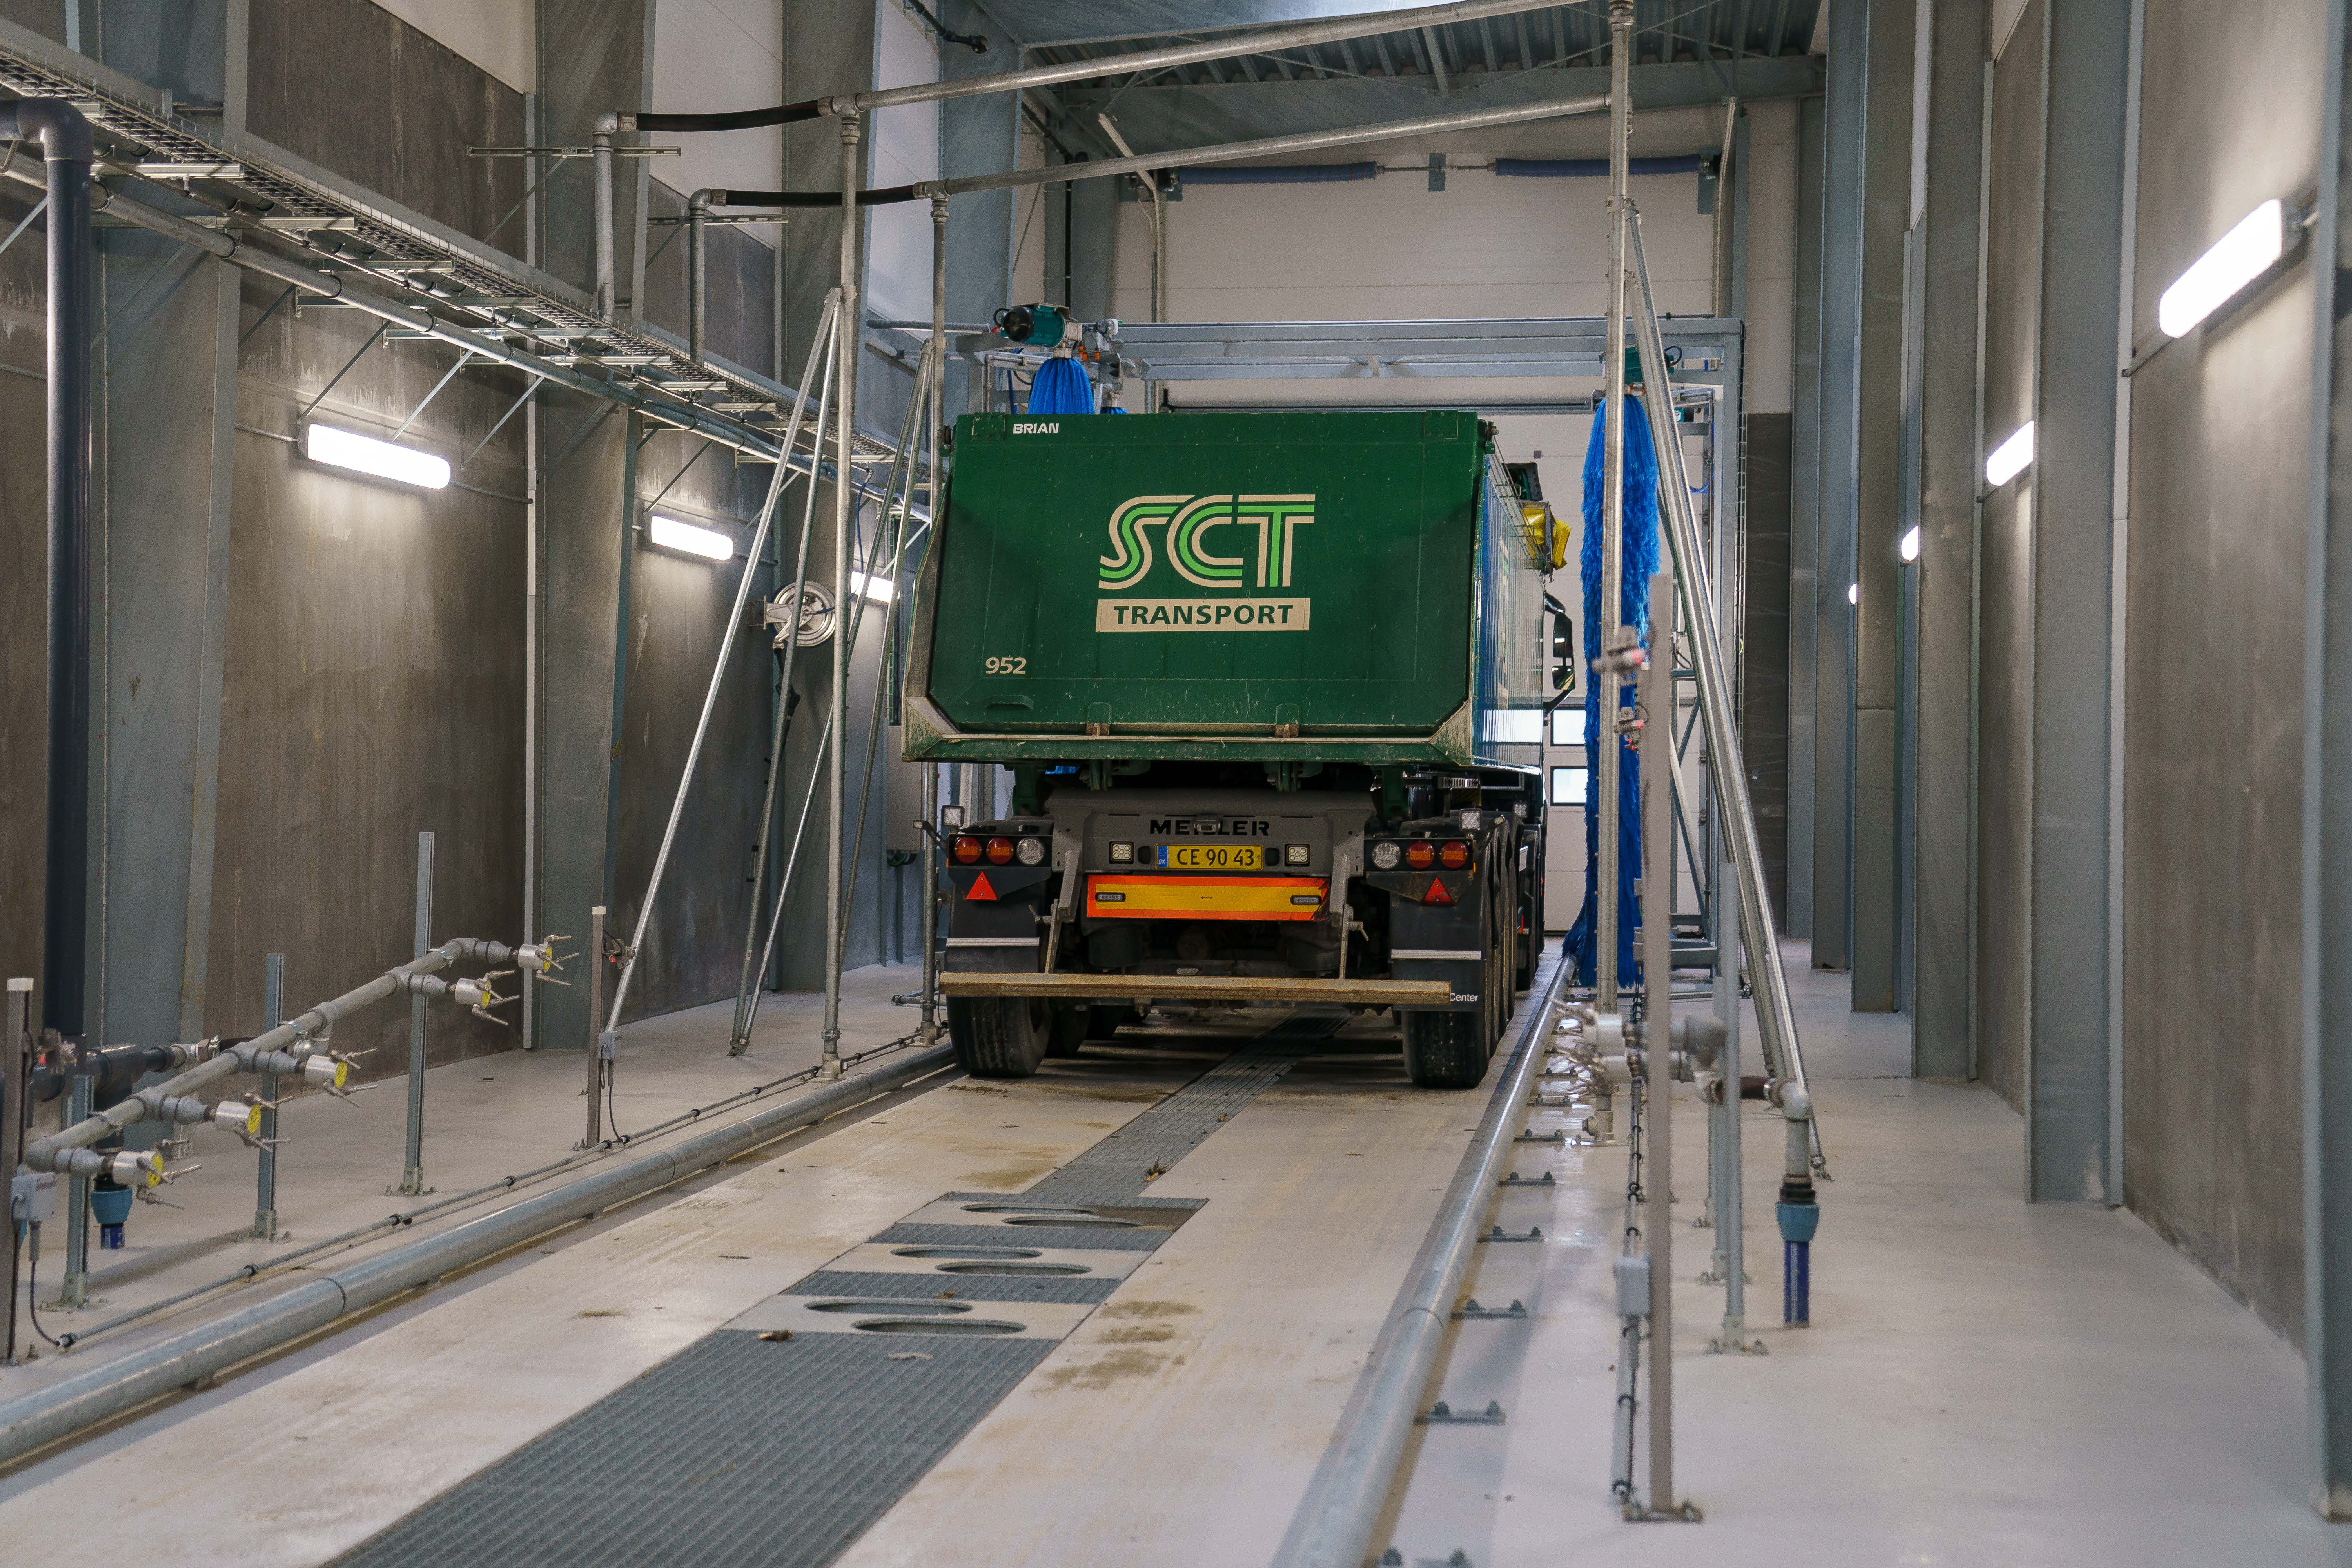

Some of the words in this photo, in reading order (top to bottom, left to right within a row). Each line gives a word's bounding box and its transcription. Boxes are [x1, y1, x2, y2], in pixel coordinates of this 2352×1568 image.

[1013, 423, 1059, 434] BRIAN
[1098, 494, 1316, 590] SCT
[1113, 605, 1294, 624] TRANSPORT
[985, 657, 1027, 674] 952
[1149, 819, 1270, 836] MELER
[1176, 848, 1200, 866] CE
[1206, 849, 1227, 866] 90
[1233, 849, 1254, 866] 43
[1450, 993, 1479, 1002] Center
